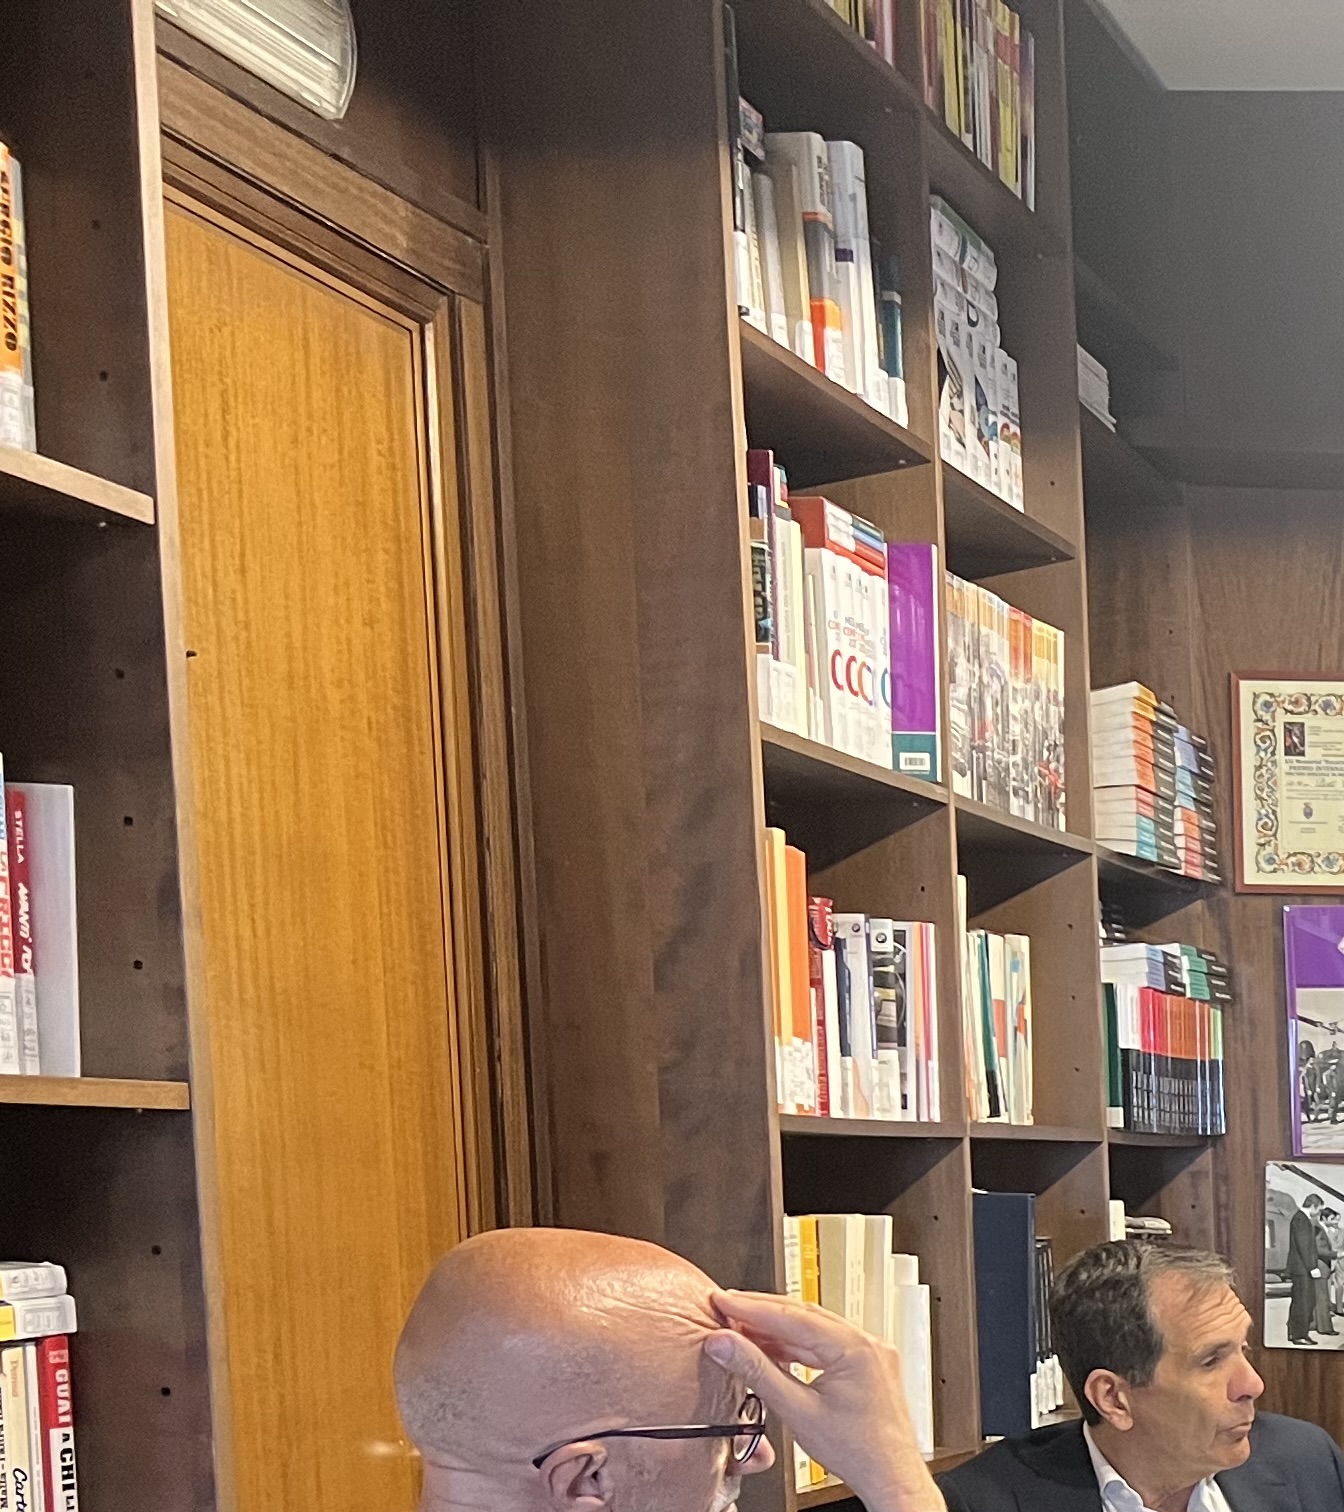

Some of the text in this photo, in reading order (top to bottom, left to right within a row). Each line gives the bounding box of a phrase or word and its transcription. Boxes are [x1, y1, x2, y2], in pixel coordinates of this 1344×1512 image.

[2, 273, 18, 352] RIZZO
[14, 810, 25, 864] STELLA
[56, 1368, 71, 1425] GUAI
[60, 1447, 75, 1491] CHI
